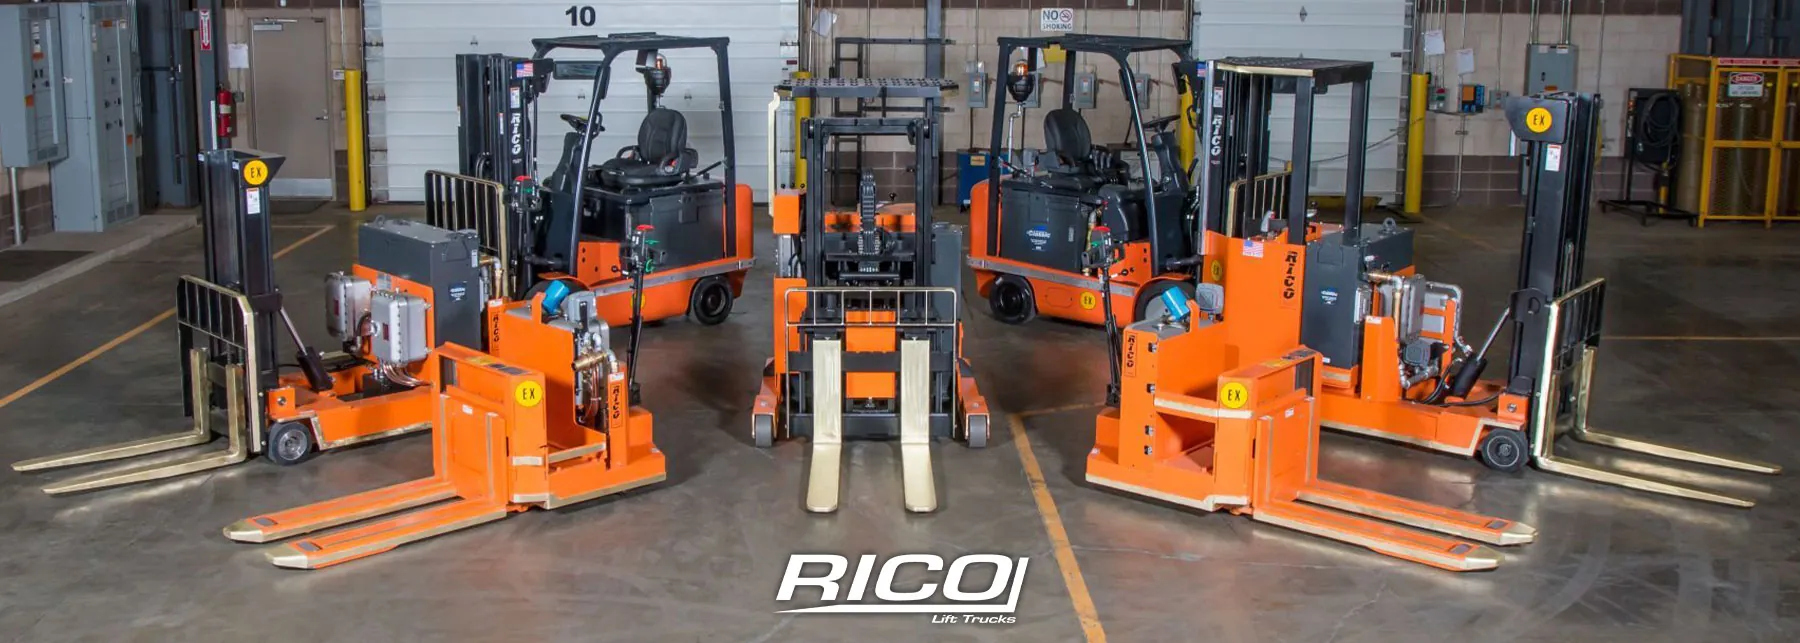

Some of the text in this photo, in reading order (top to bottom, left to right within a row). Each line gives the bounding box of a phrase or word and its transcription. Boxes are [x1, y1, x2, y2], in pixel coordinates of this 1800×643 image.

[565, 5, 596, 26] 10
[1042, 10, 1059, 20] NO
[1533, 114, 1545, 126] EX
[511, 112, 521, 155] RICO
[1211, 114, 1223, 156] RICO
[250, 167, 262, 179] EX
[1283, 251, 1298, 300] RICO
[1084, 295, 1093, 305] EX
[492, 314, 500, 342] RICO
[1126, 335, 1136, 368] RICO
[522, 388, 535, 400] EX
[612, 385, 621, 419] RICO
[1227, 389, 1241, 402] EX
